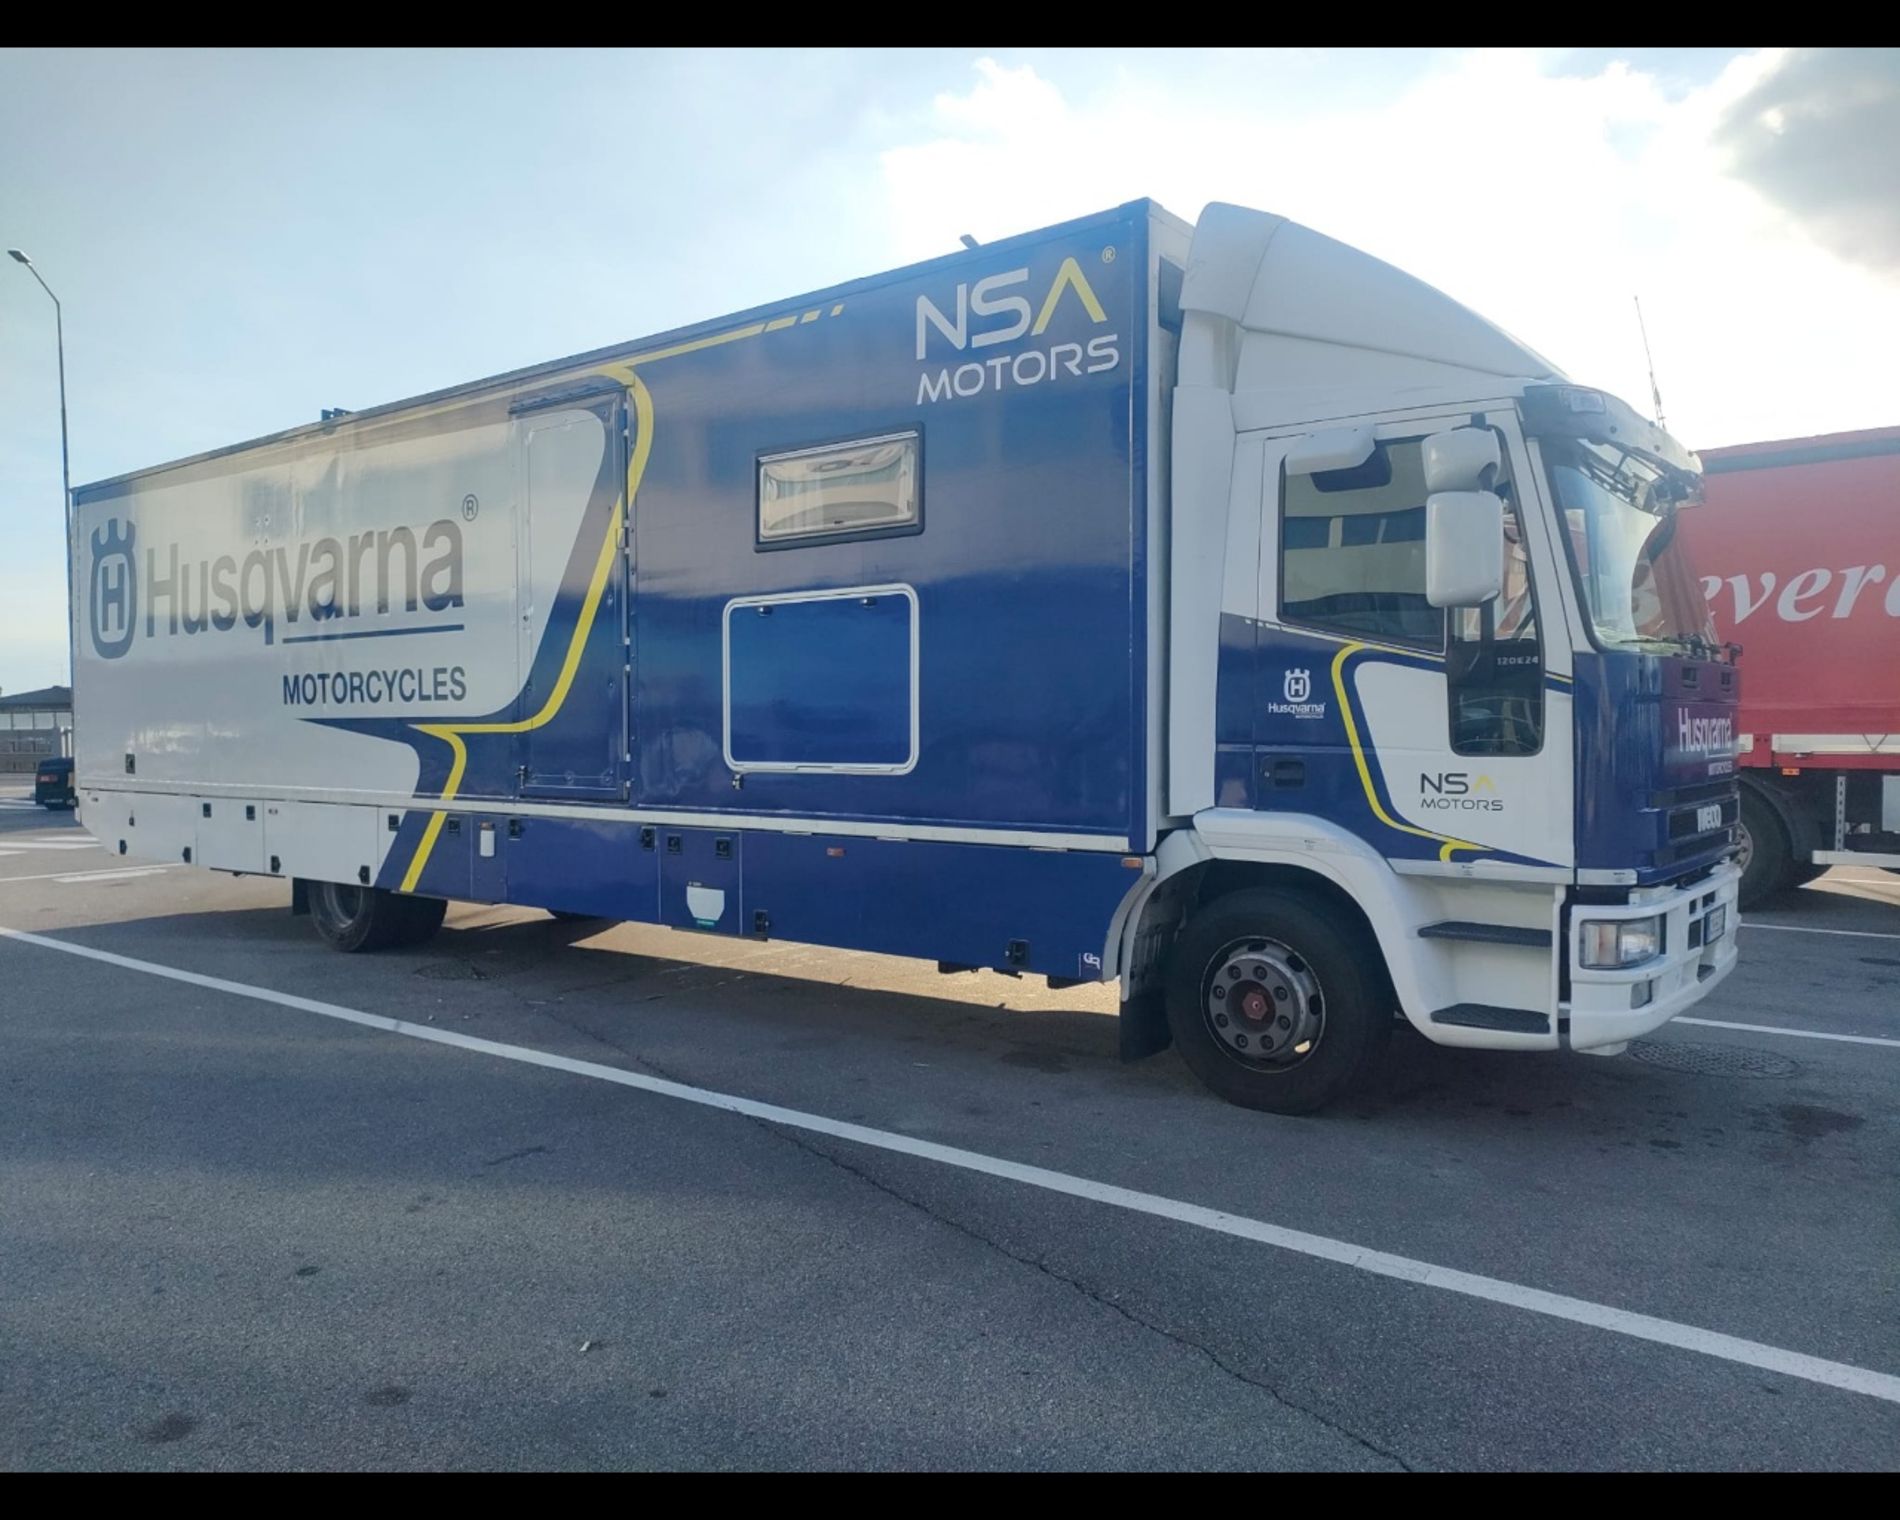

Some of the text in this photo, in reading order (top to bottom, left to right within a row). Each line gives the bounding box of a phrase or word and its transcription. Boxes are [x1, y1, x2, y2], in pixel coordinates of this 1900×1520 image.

[916, 256, 1107, 361] NSA
[916, 333, 1120, 406] MOTORS
[146, 518, 465, 646] Husqvarna
[282, 666, 467, 706] MOTORCYCLES
[1267, 702, 1325, 715] Husqvarna
[1420, 772, 1497, 795] NSA
[1420, 797, 1504, 812] MOTORS
